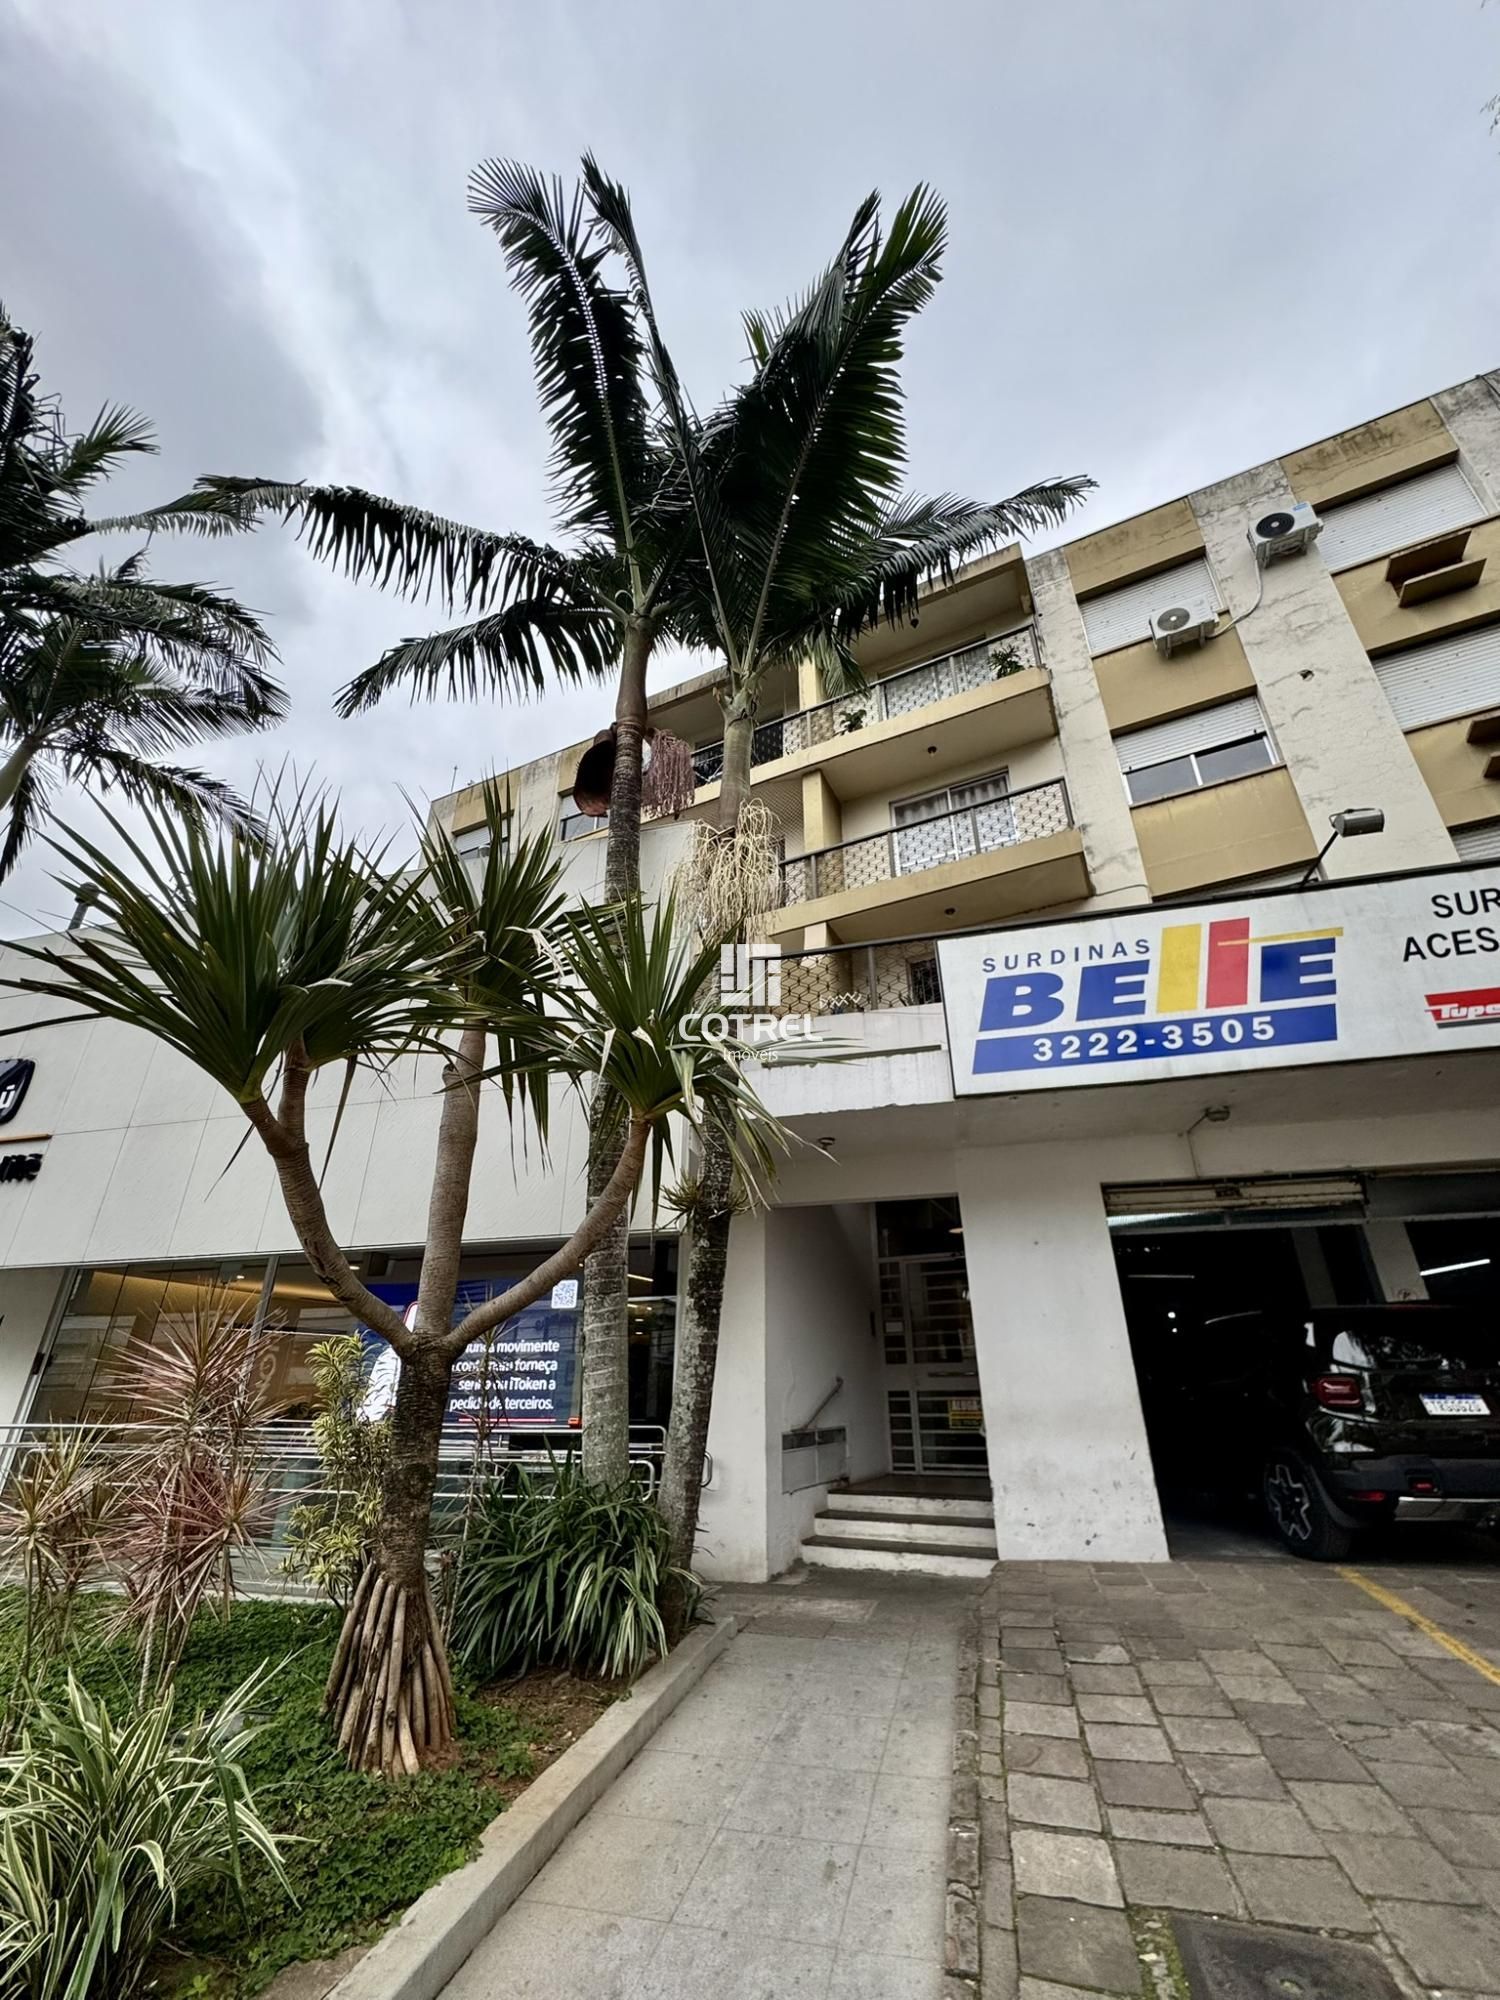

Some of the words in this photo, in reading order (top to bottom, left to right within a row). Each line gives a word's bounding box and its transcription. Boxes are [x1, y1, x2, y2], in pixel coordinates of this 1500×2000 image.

[1403, 926, 1500, 962] ACES
[982, 938, 1151, 973] SURDINAS
[1032, 1015, 1275, 1063] 3222-3505
[497, 1339, 560, 1354] movimente
[514, 1358, 558, 1375] forneça
[549, 1380, 557, 1391] a
[504, 1395, 555, 1411] terceiros.
